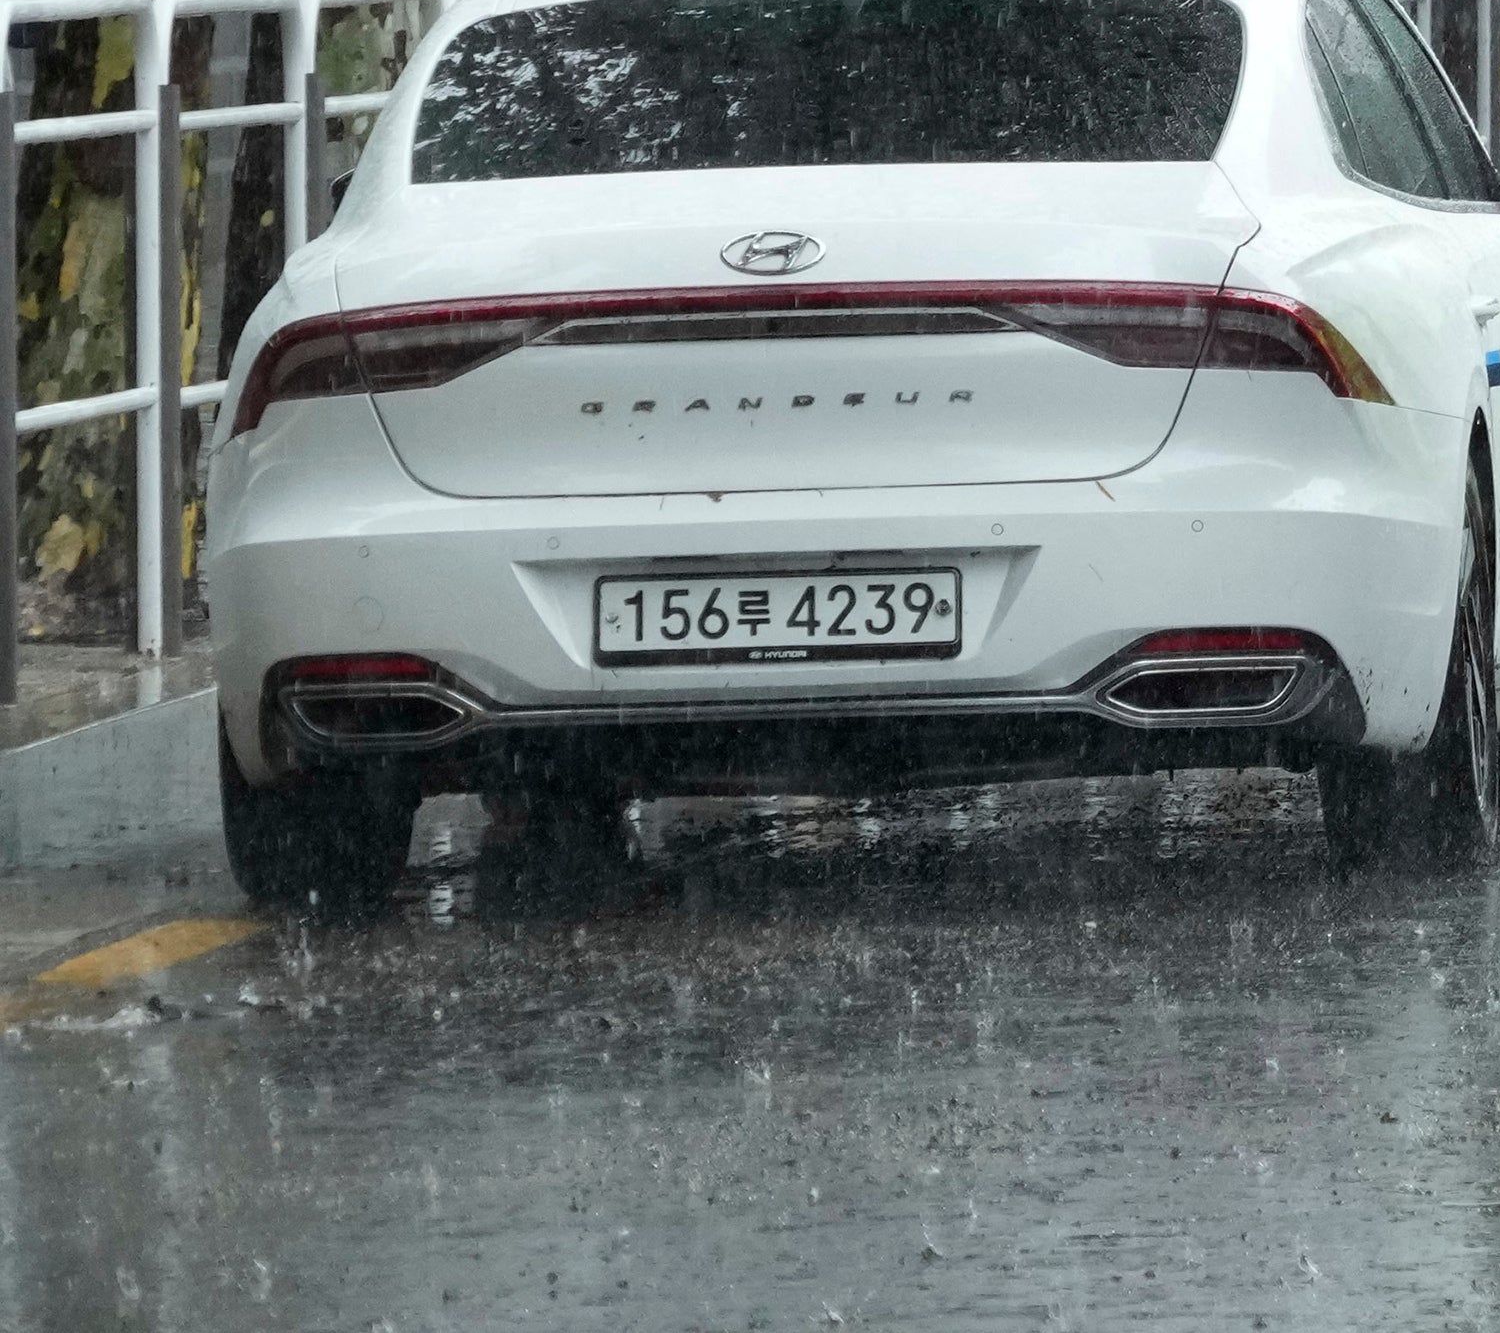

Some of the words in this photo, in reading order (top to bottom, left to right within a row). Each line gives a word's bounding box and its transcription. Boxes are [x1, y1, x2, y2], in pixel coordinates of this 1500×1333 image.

[580, 388, 975, 415] GRANDEUR
[623, 587, 771, 642] 156루
[785, 582, 935, 637] 4239
[764, 649, 807, 660] HYUNDAI
